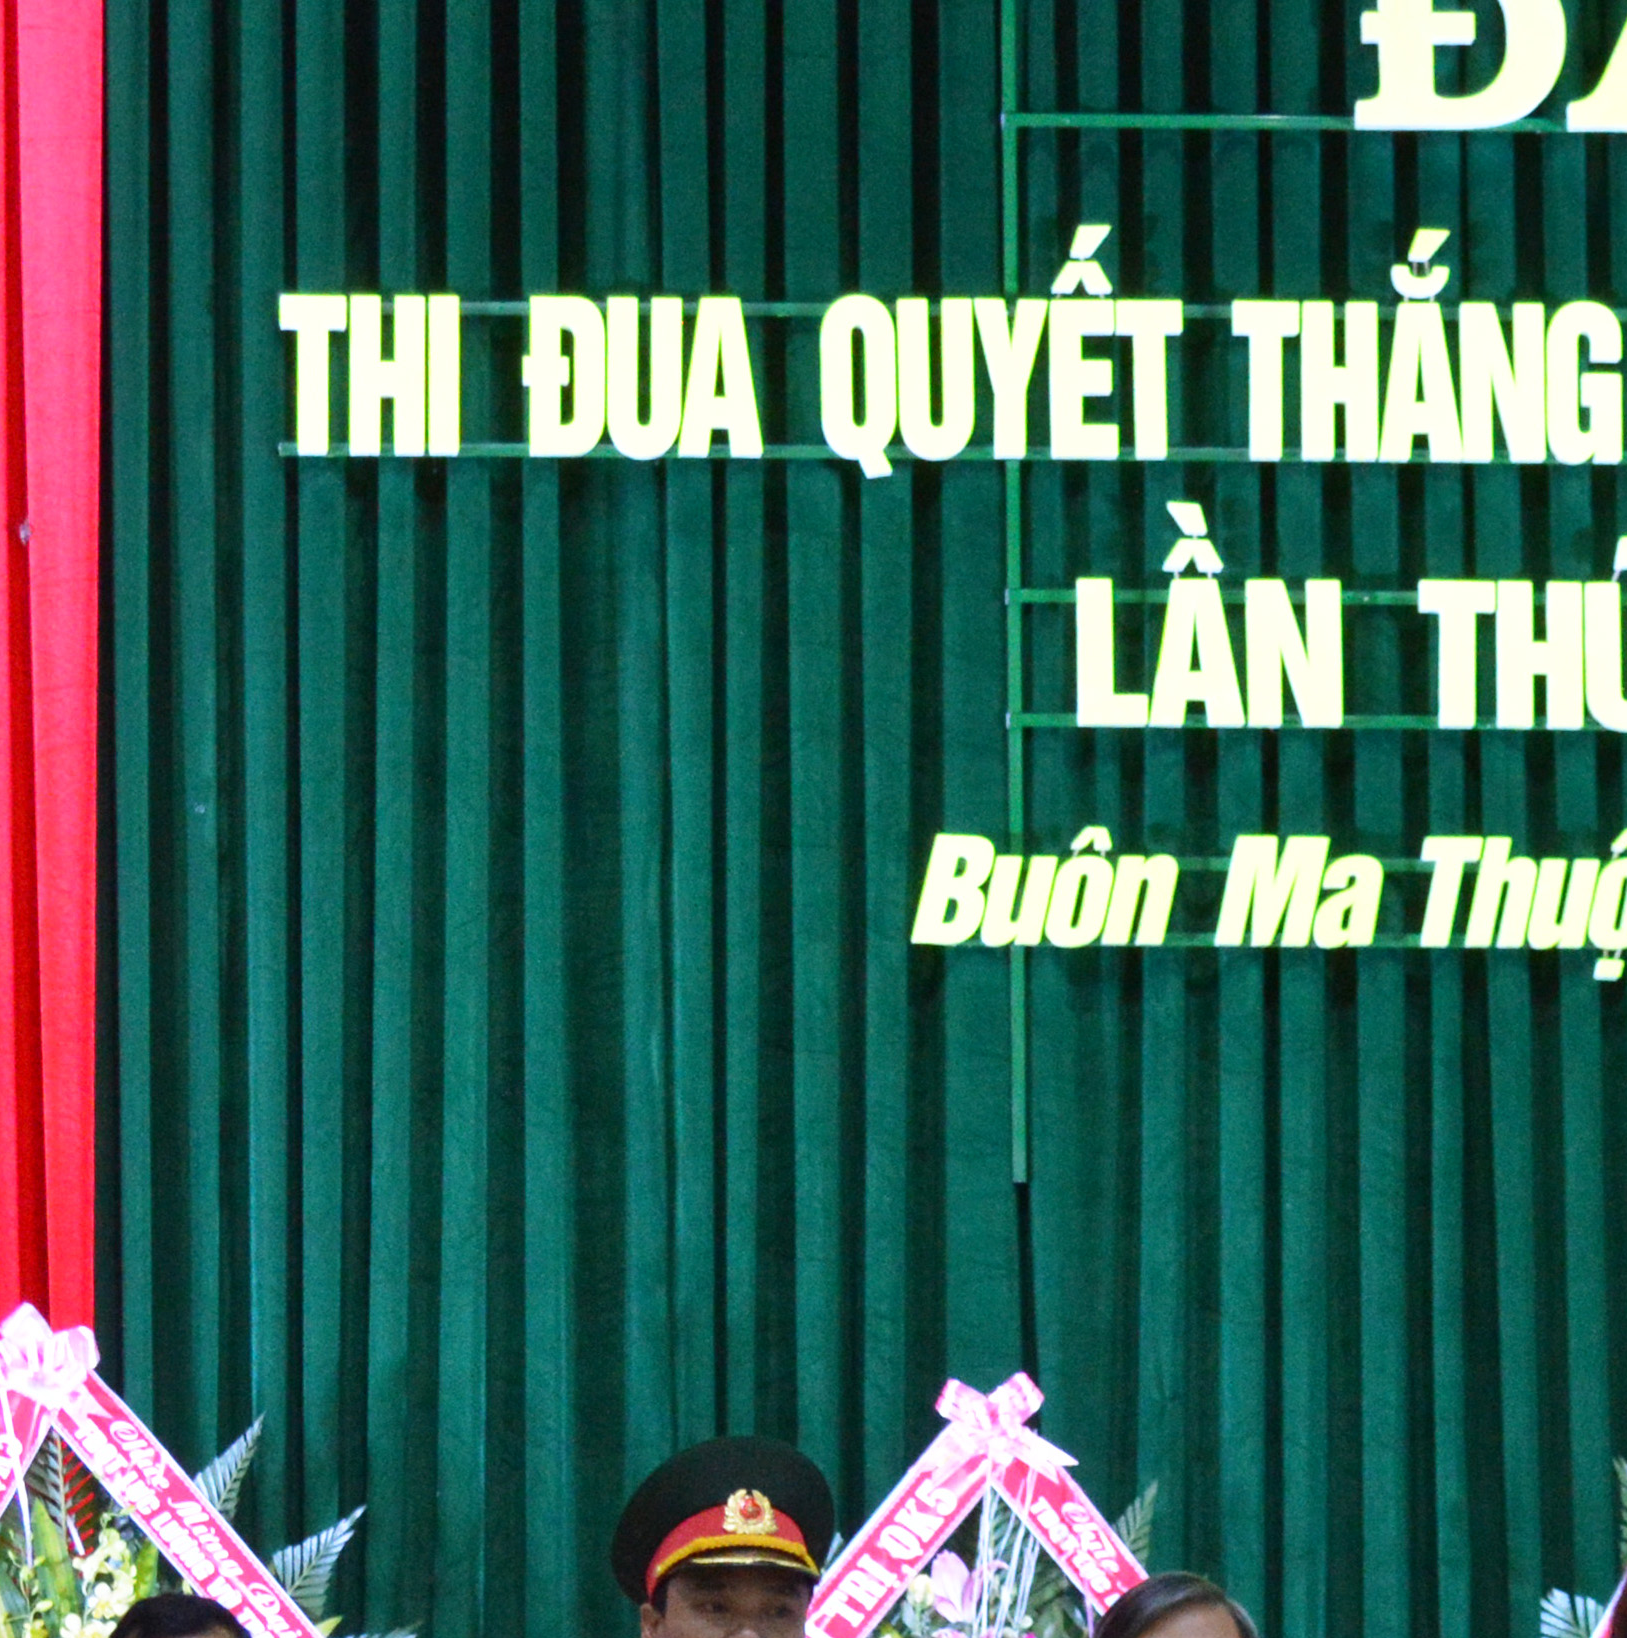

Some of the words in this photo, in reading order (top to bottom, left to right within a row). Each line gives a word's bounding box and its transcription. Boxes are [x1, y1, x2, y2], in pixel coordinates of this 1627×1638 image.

[277, 292, 461, 458] THI
[521, 294, 765, 462] ĐUA
[818, 223, 1184, 480] QUYẾT
[1230, 228, 1624, 466] THẮNG
[1074, 500, 1344, 730] LẦN
[909, 825, 1179, 949] Buôn
[1213, 834, 1384, 950] Ma
[877, 1474, 959, 1564] QK5
